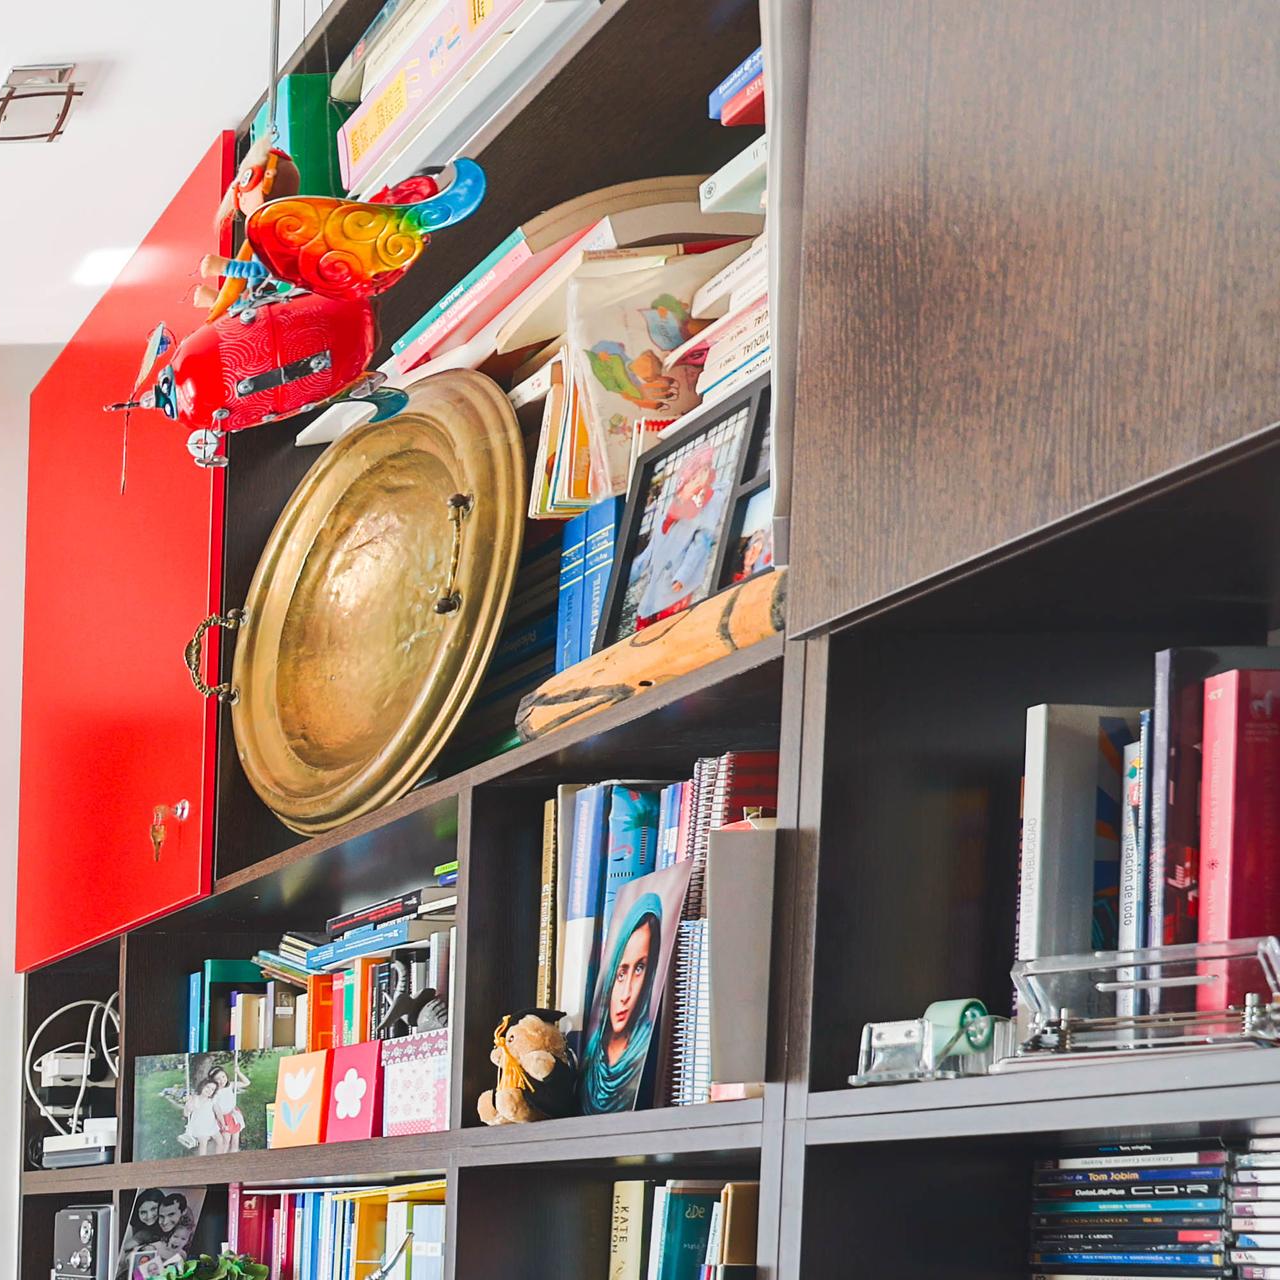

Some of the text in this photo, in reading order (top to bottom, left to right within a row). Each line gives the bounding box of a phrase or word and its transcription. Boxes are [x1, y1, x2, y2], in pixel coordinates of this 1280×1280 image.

[1088, 1172, 1108, 1182] Tom
[1111, 1171, 1139, 1180] Jobim
[611, 1195, 622, 1254] MORTON
[619, 1206, 629, 1243] KATE
